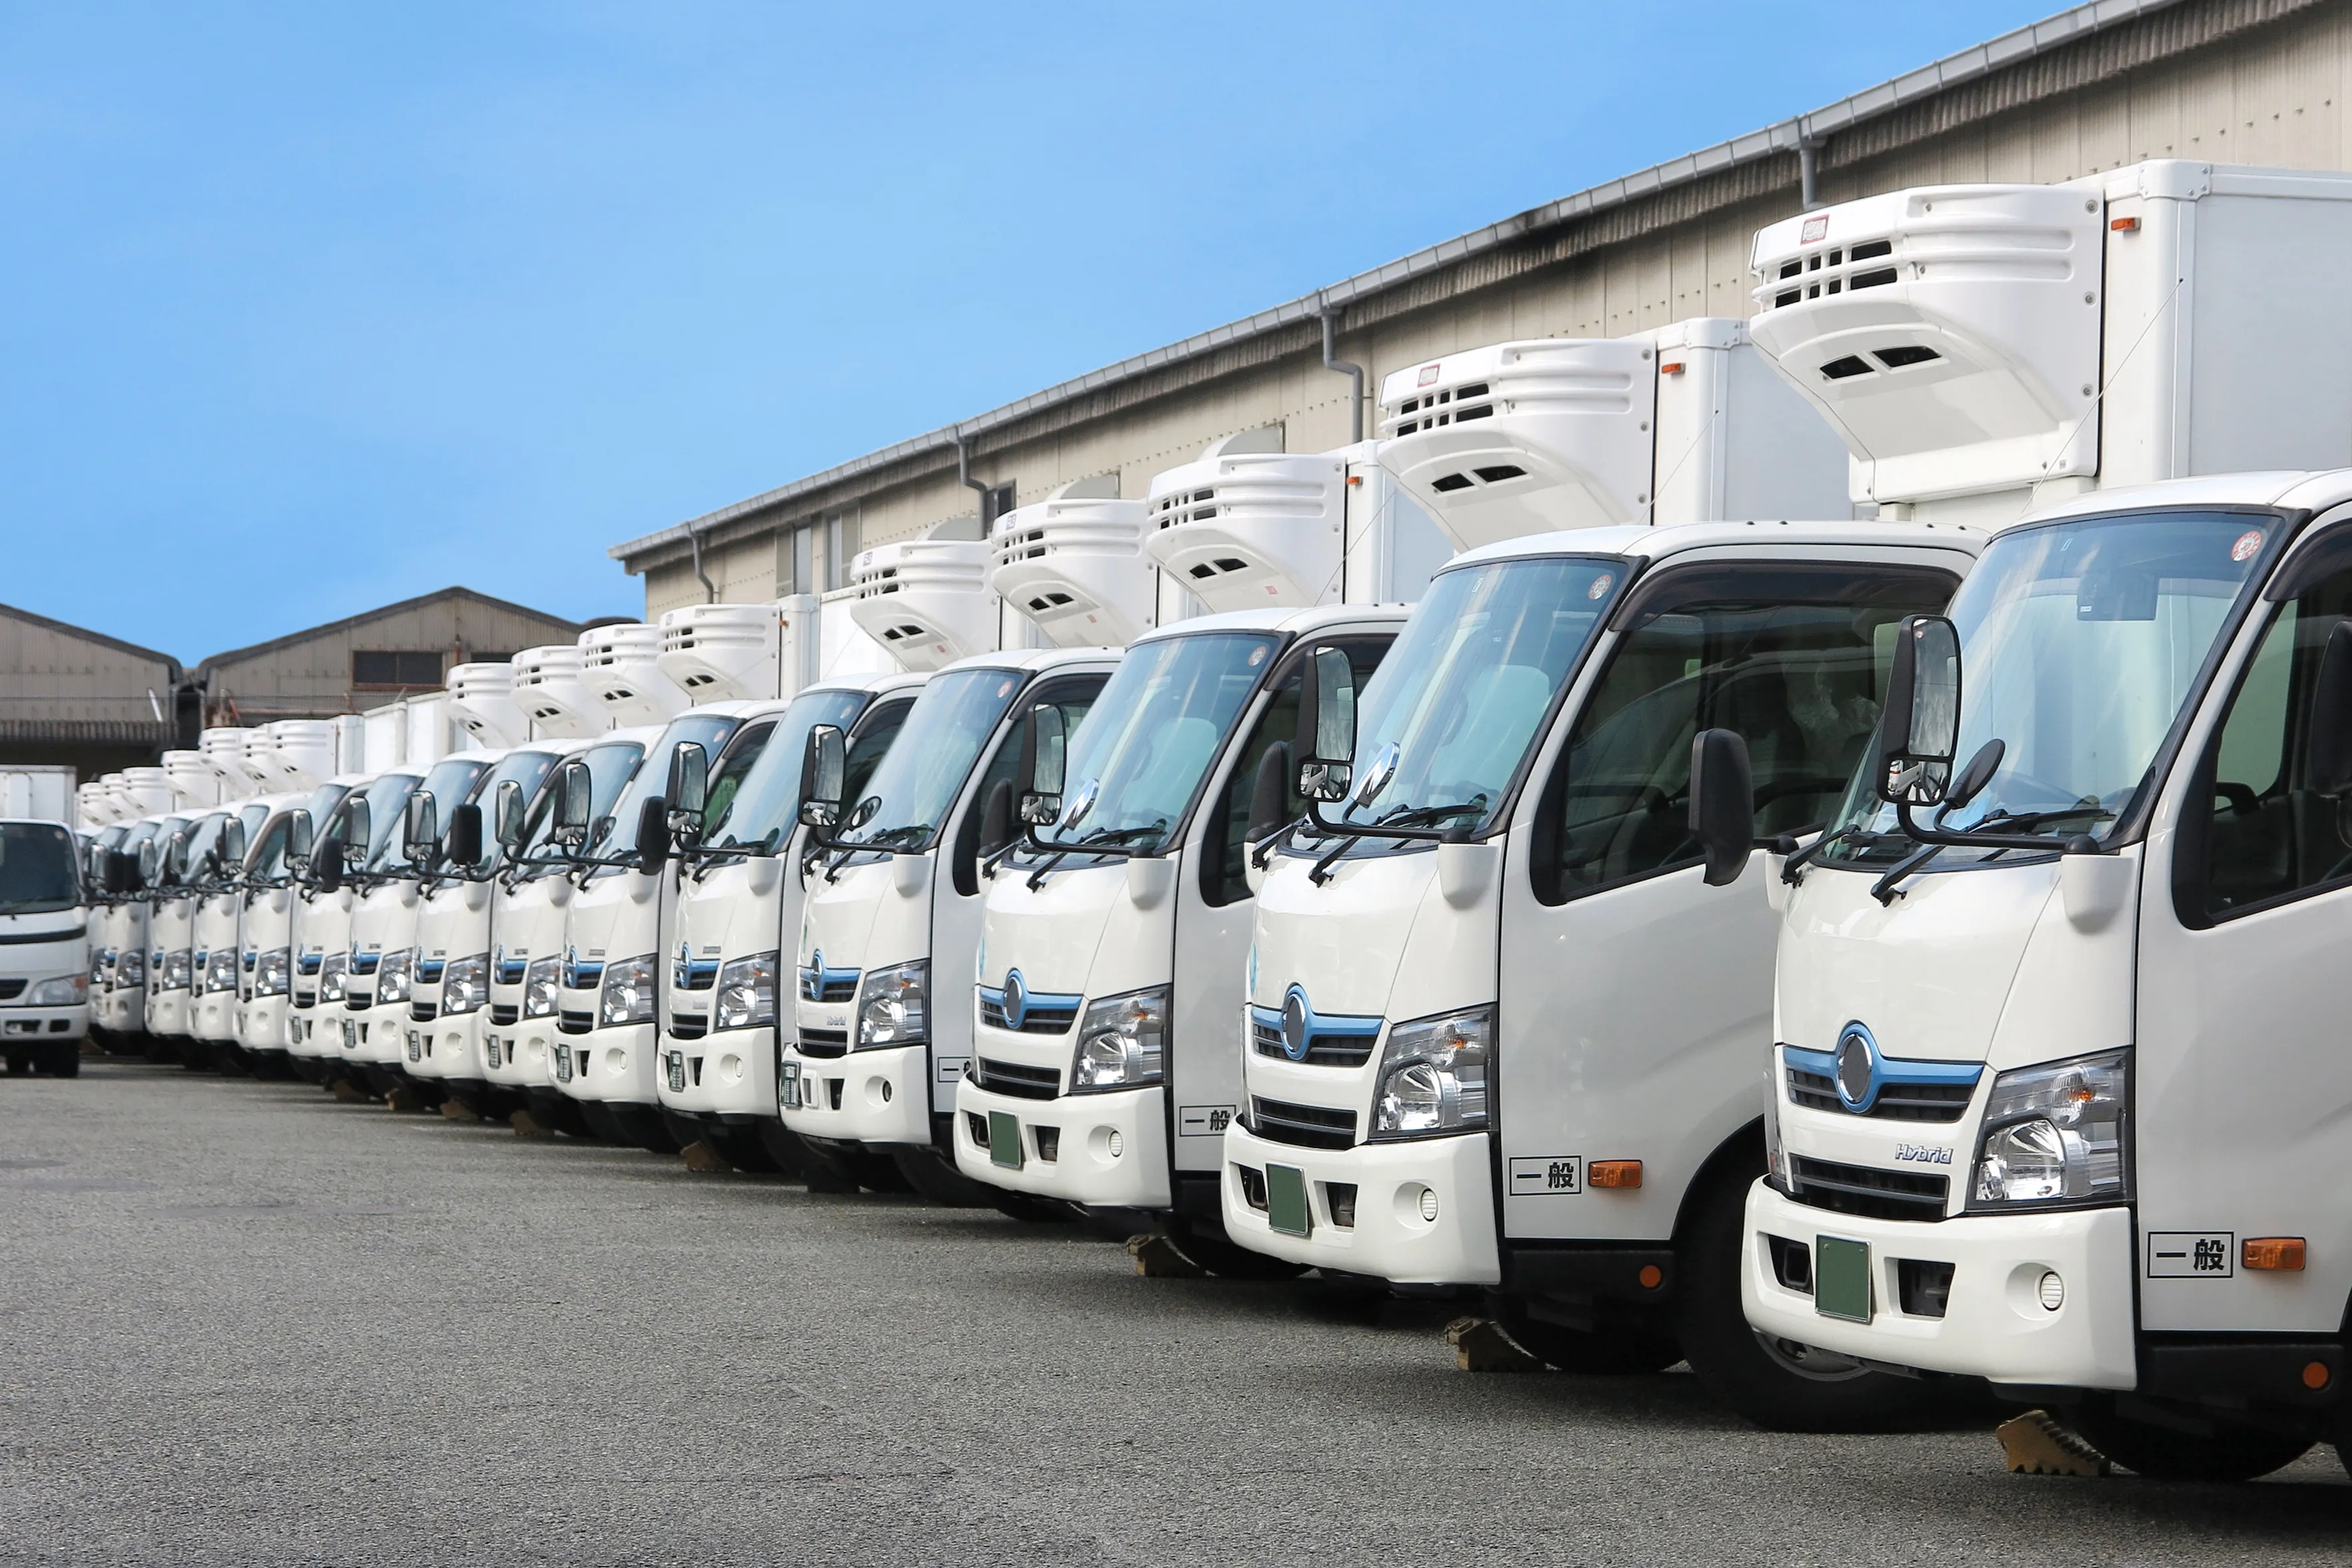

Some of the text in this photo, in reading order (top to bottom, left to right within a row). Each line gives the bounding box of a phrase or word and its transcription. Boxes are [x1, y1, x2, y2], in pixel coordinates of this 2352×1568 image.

[1185, 1109, 1230, 1131] 一般
[1895, 1143, 1953, 1164] Hybrid
[1517, 1162, 1574, 1189] 一般
[2156, 1239, 2224, 1271] 一般
